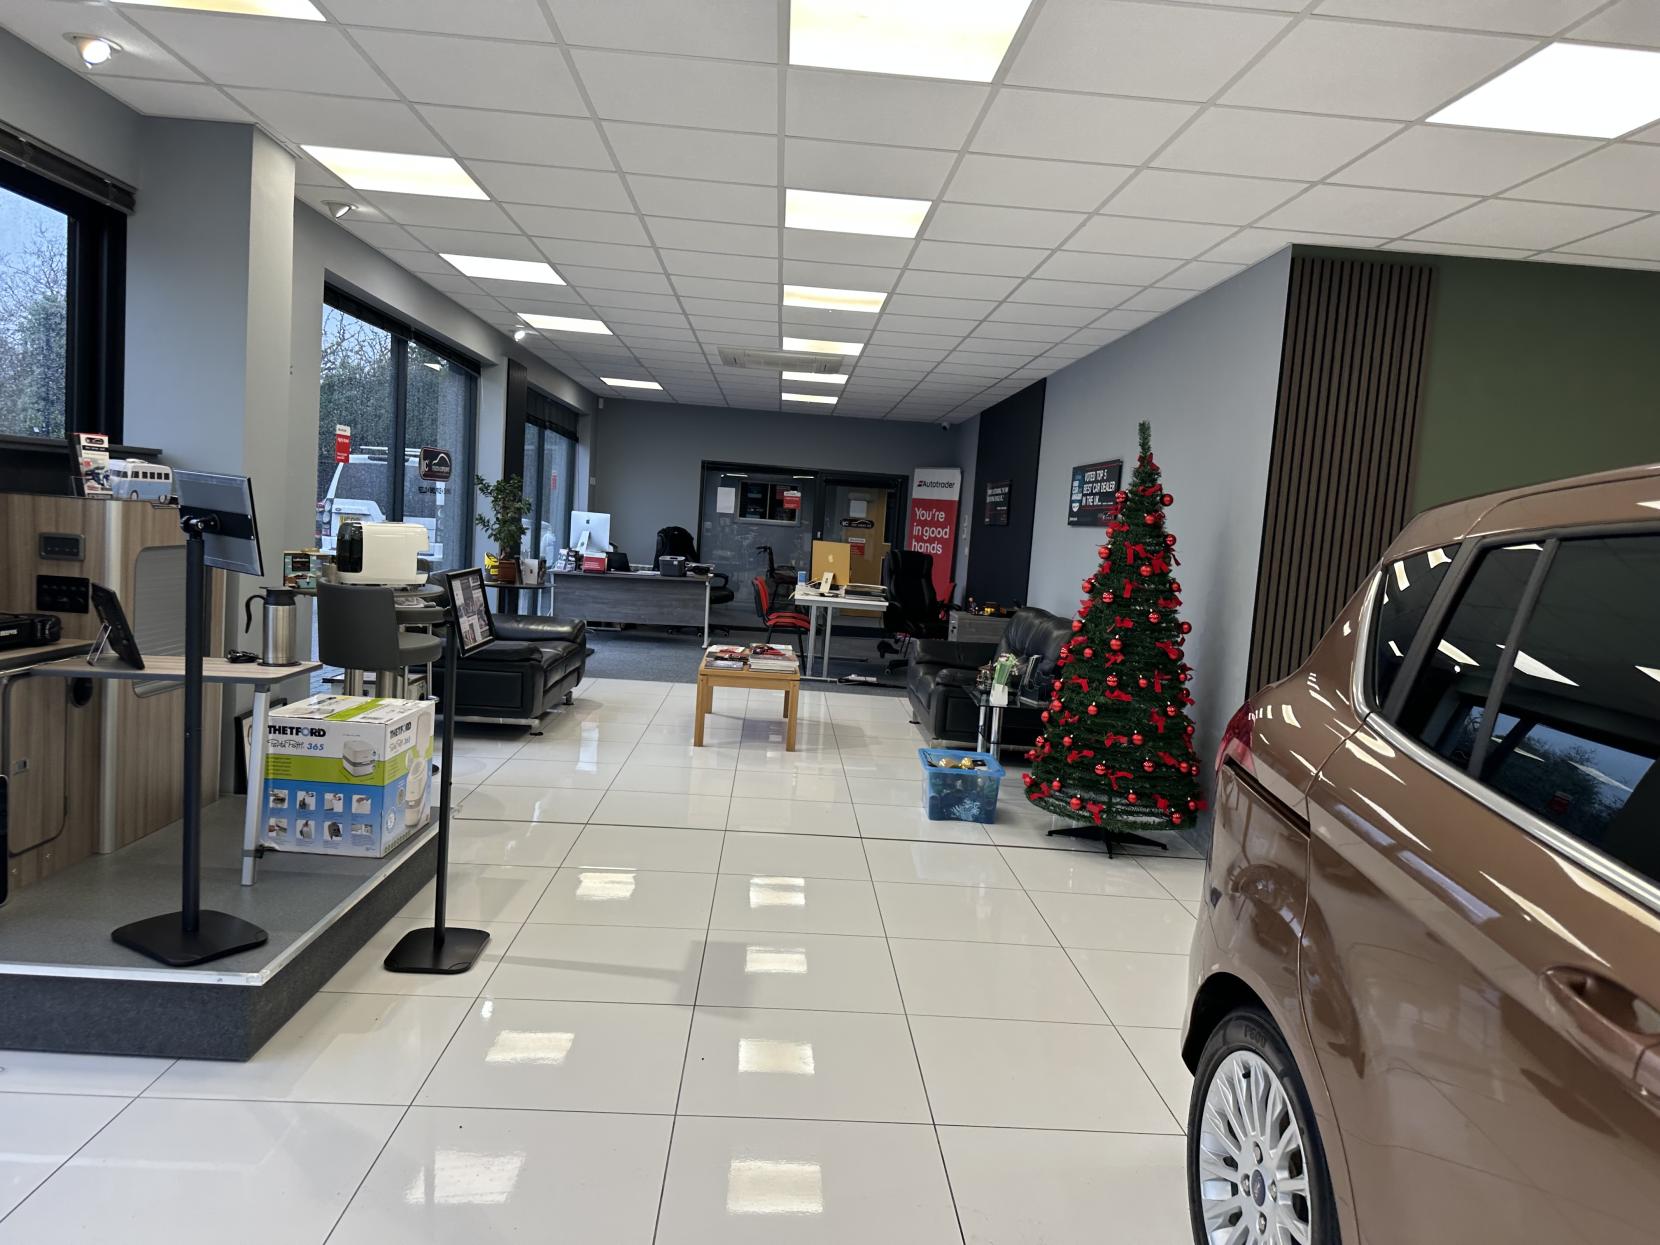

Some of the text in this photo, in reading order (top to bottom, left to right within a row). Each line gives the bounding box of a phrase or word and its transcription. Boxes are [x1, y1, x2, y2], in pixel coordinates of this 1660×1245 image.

[922, 480, 955, 488] Autotrader
[1084, 484, 1092, 494] BEST
[1101, 481, 1115, 492] DEALER
[915, 508, 945, 521] You're
[913, 523, 949, 539] in good
[912, 539, 942, 554] hands
[268, 725, 326, 738] THETFORD
